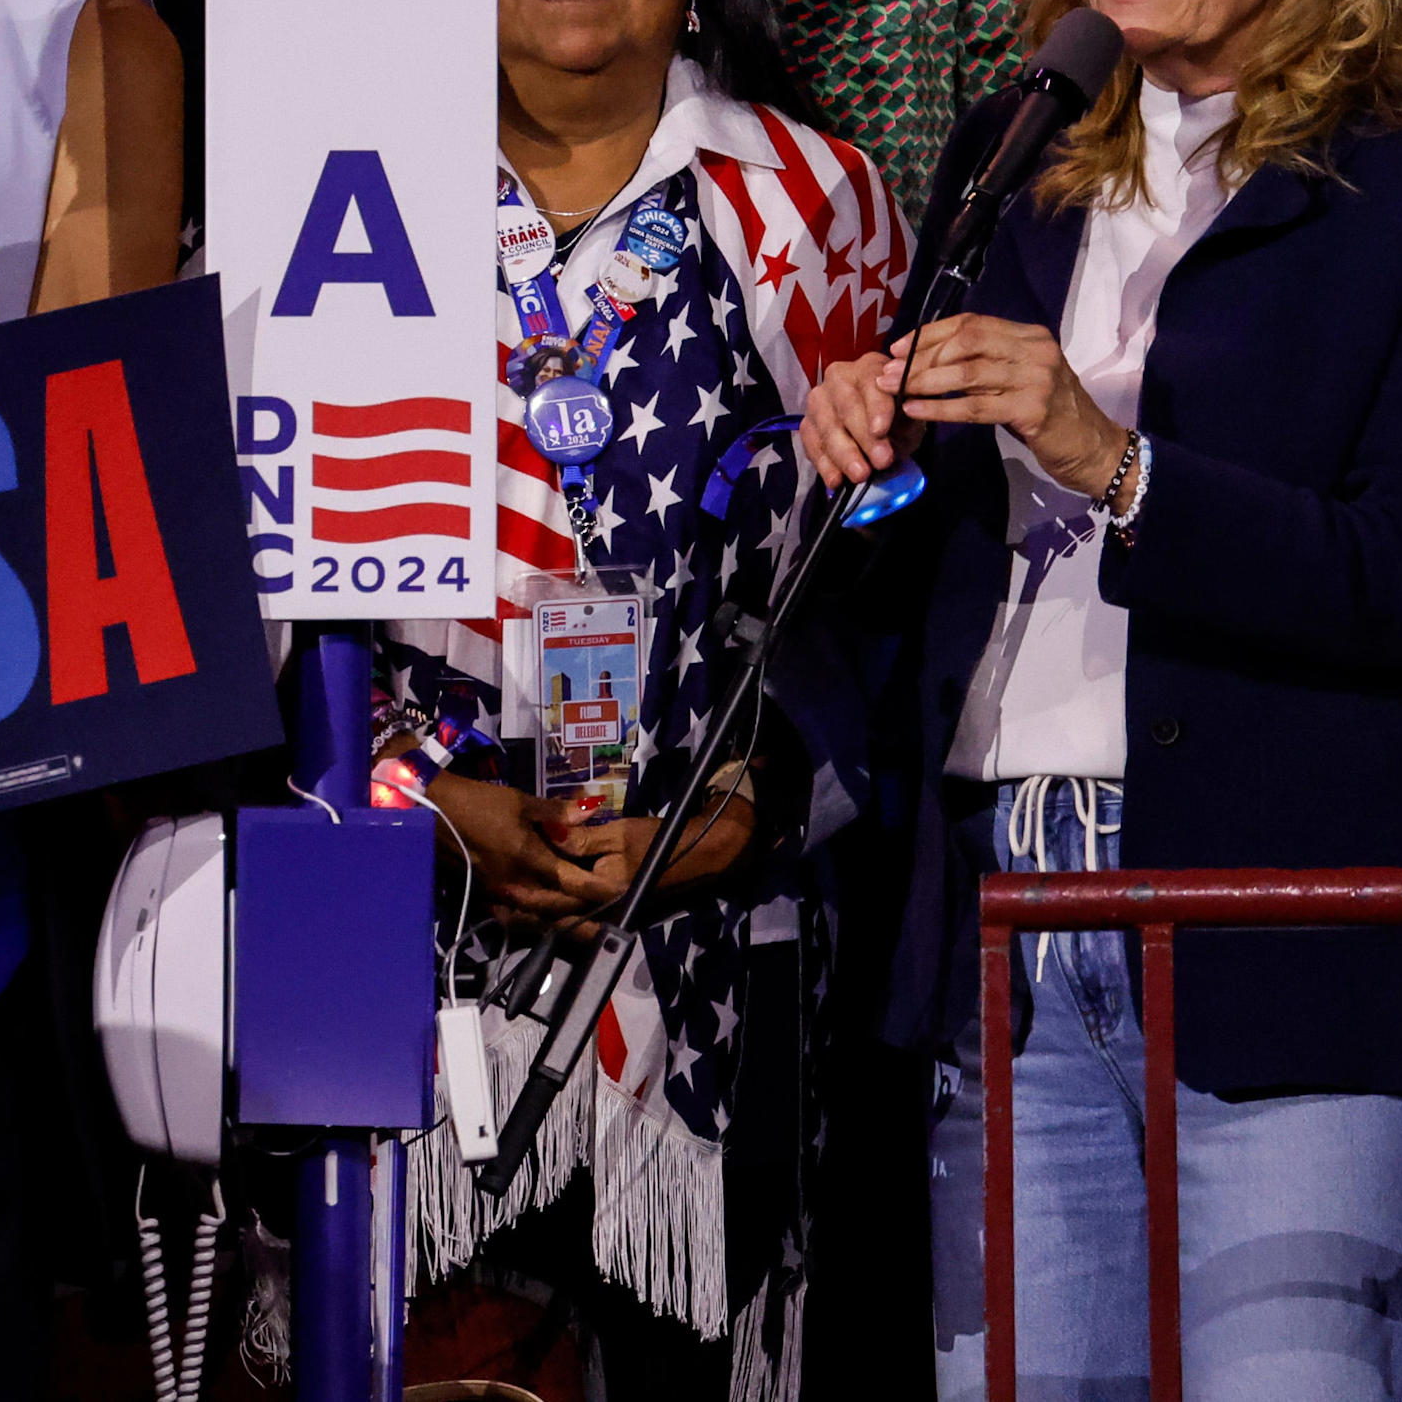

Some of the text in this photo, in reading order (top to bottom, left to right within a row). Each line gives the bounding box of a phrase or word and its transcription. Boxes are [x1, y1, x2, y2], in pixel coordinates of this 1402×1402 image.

[628, 226, 645, 238] IOWA
[637, 211, 684, 242] CHICAGO
[652, 224, 670, 236] 2024
[509, 238, 551, 253] COUNCIL
[644, 238, 665, 251] PARTY
[593, 292, 615, 321] Votes
[567, 434, 590, 445] 2024
[236, 396, 298, 594] DNC
[311, 556, 470, 593] 2024
[627, 606, 635, 626] 2
[569, 636, 611, 645] TUESDAY
